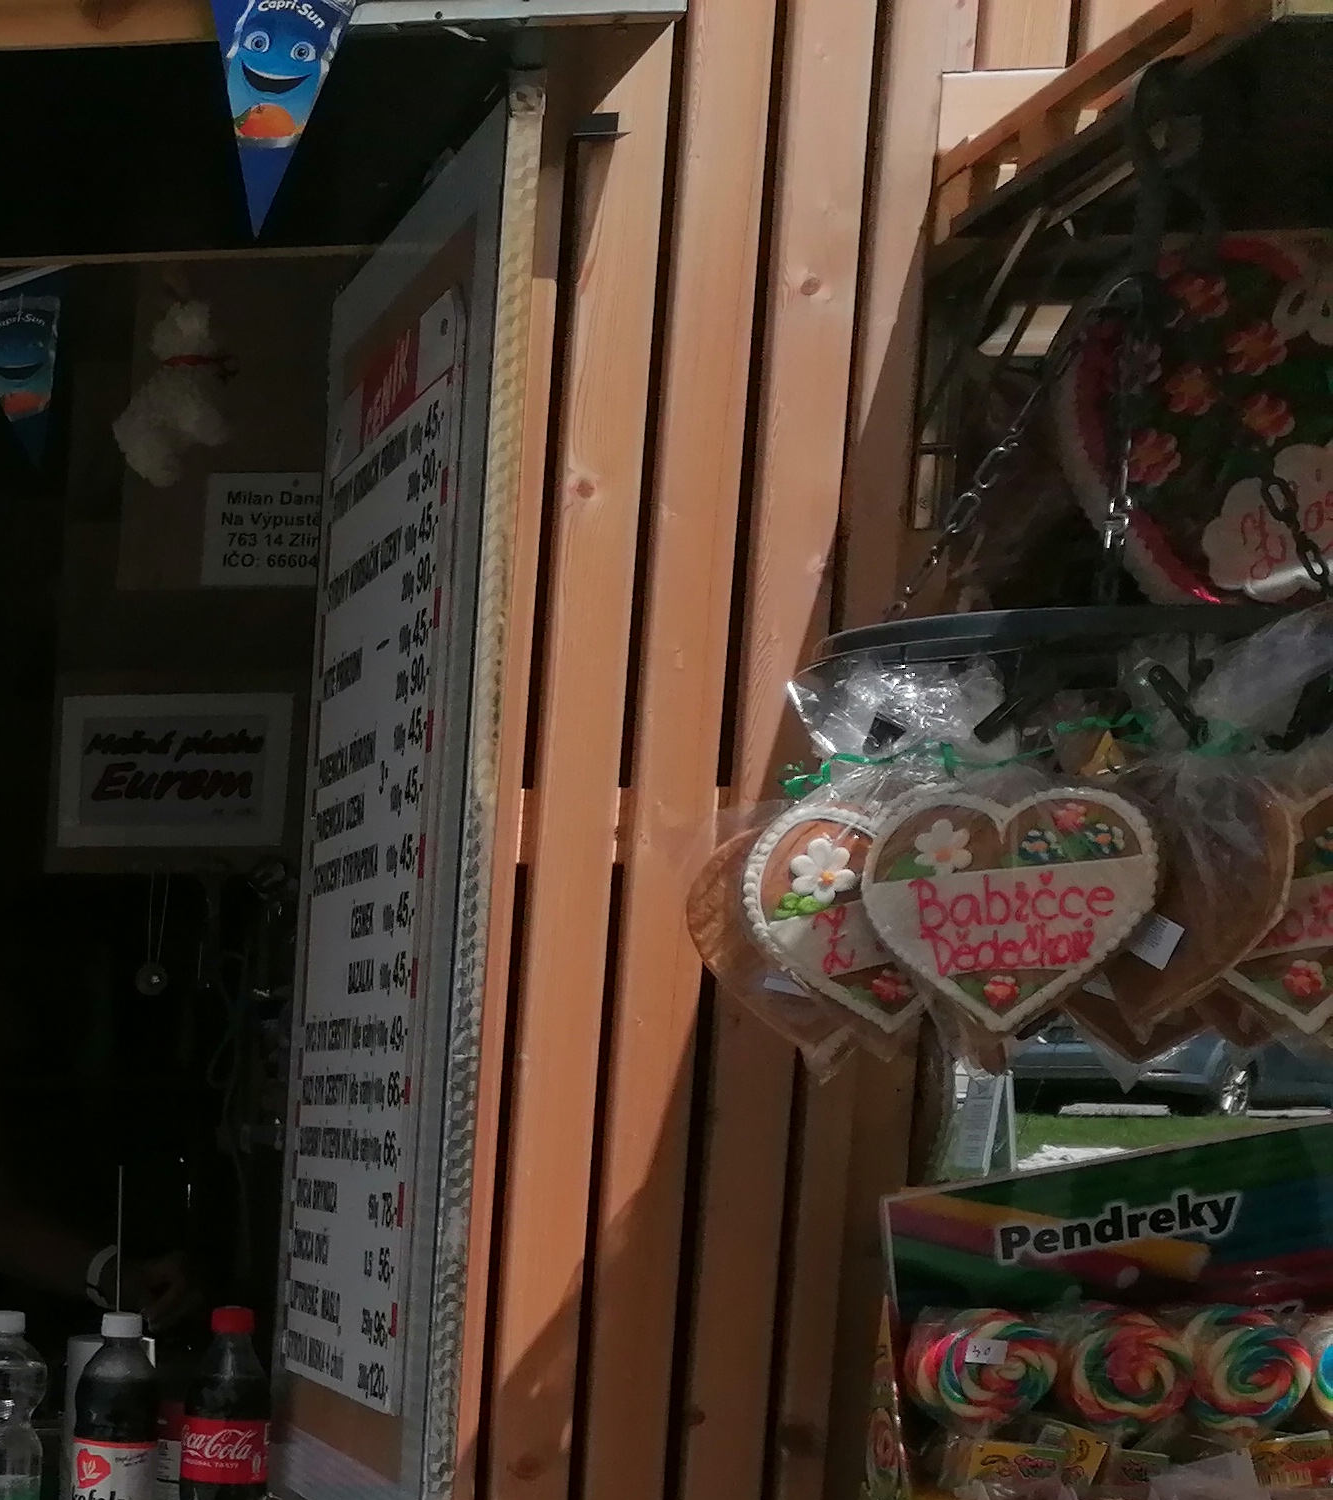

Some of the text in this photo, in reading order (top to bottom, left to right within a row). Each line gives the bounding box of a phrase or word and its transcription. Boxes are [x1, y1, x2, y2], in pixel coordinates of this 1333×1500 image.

[227, 490, 273, 505] Milan
[221, 511, 244, 526] Na
[264, 533, 284, 547] 14
[222, 550, 260, 568] IČO:
[999, 1193, 1237, 1262] Pendreky
